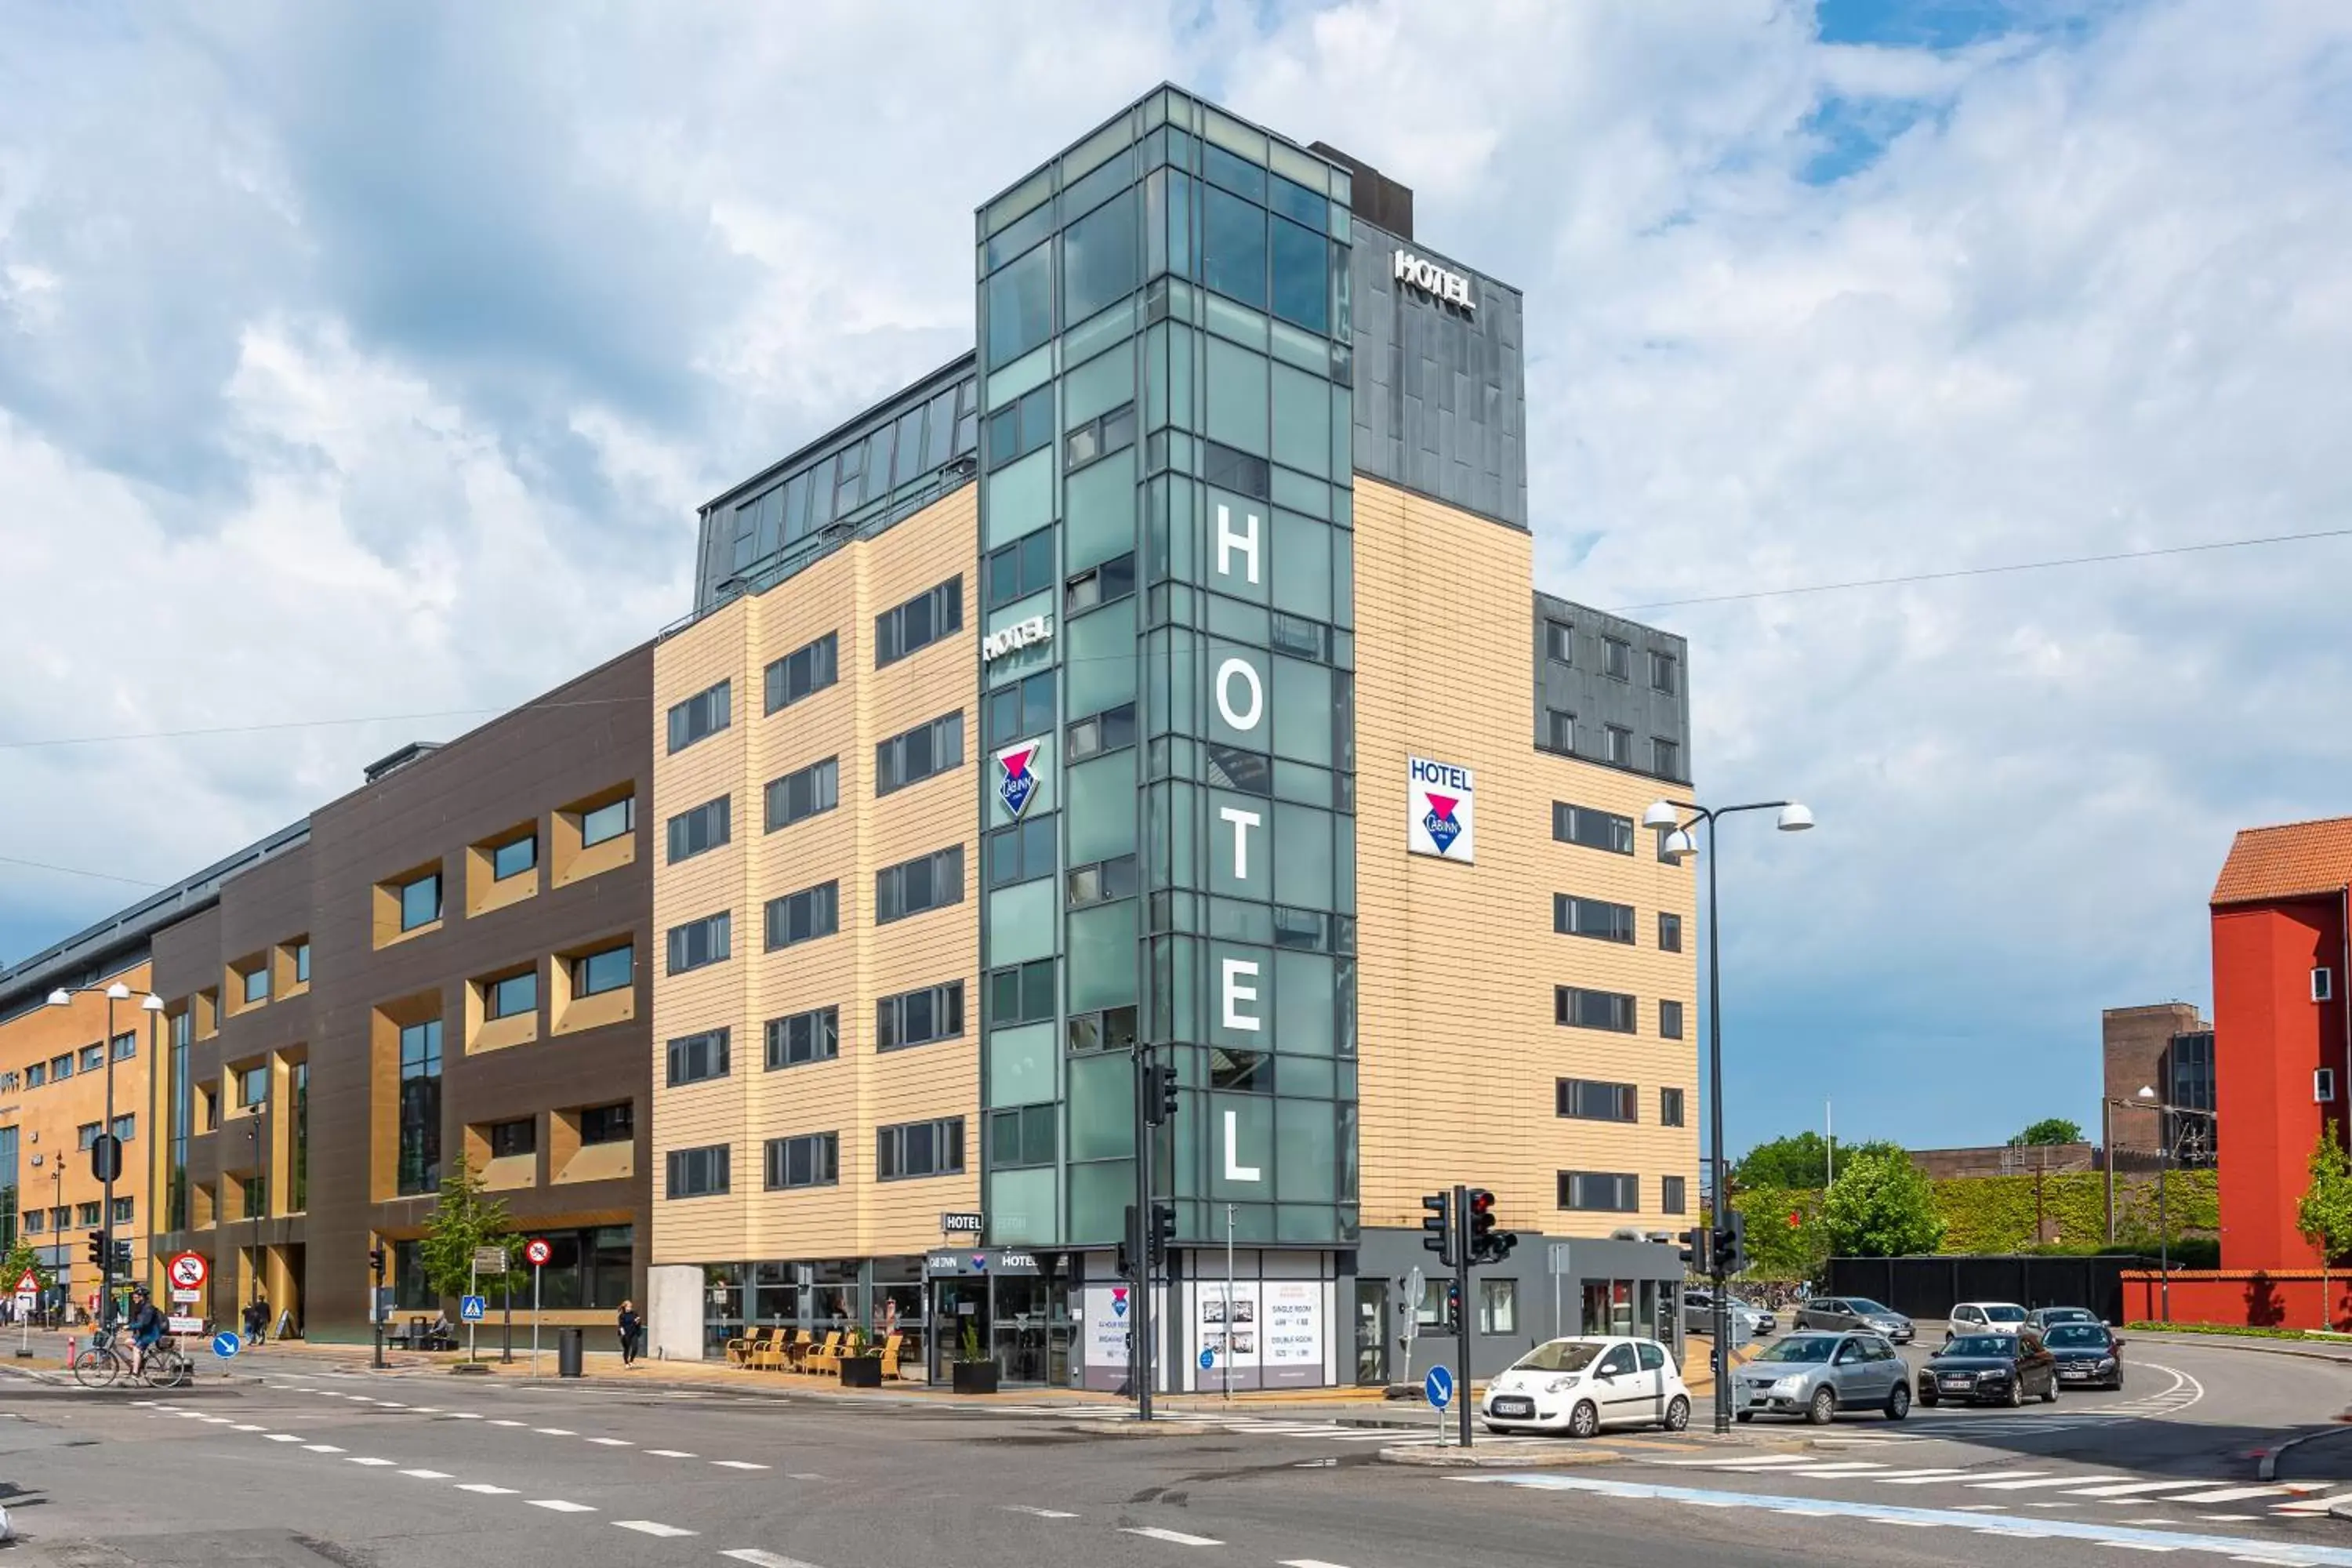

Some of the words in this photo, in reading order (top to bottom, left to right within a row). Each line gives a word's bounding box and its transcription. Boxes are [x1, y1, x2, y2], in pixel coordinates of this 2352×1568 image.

[1395, 250, 1475, 309] HOTEL
[983, 616, 1055, 661] HOTEL
[1412, 759, 1472, 791] HOTEL
[1217, 506, 1261, 1181] HOTEL
[946, 1216, 982, 1229] HOTEL
